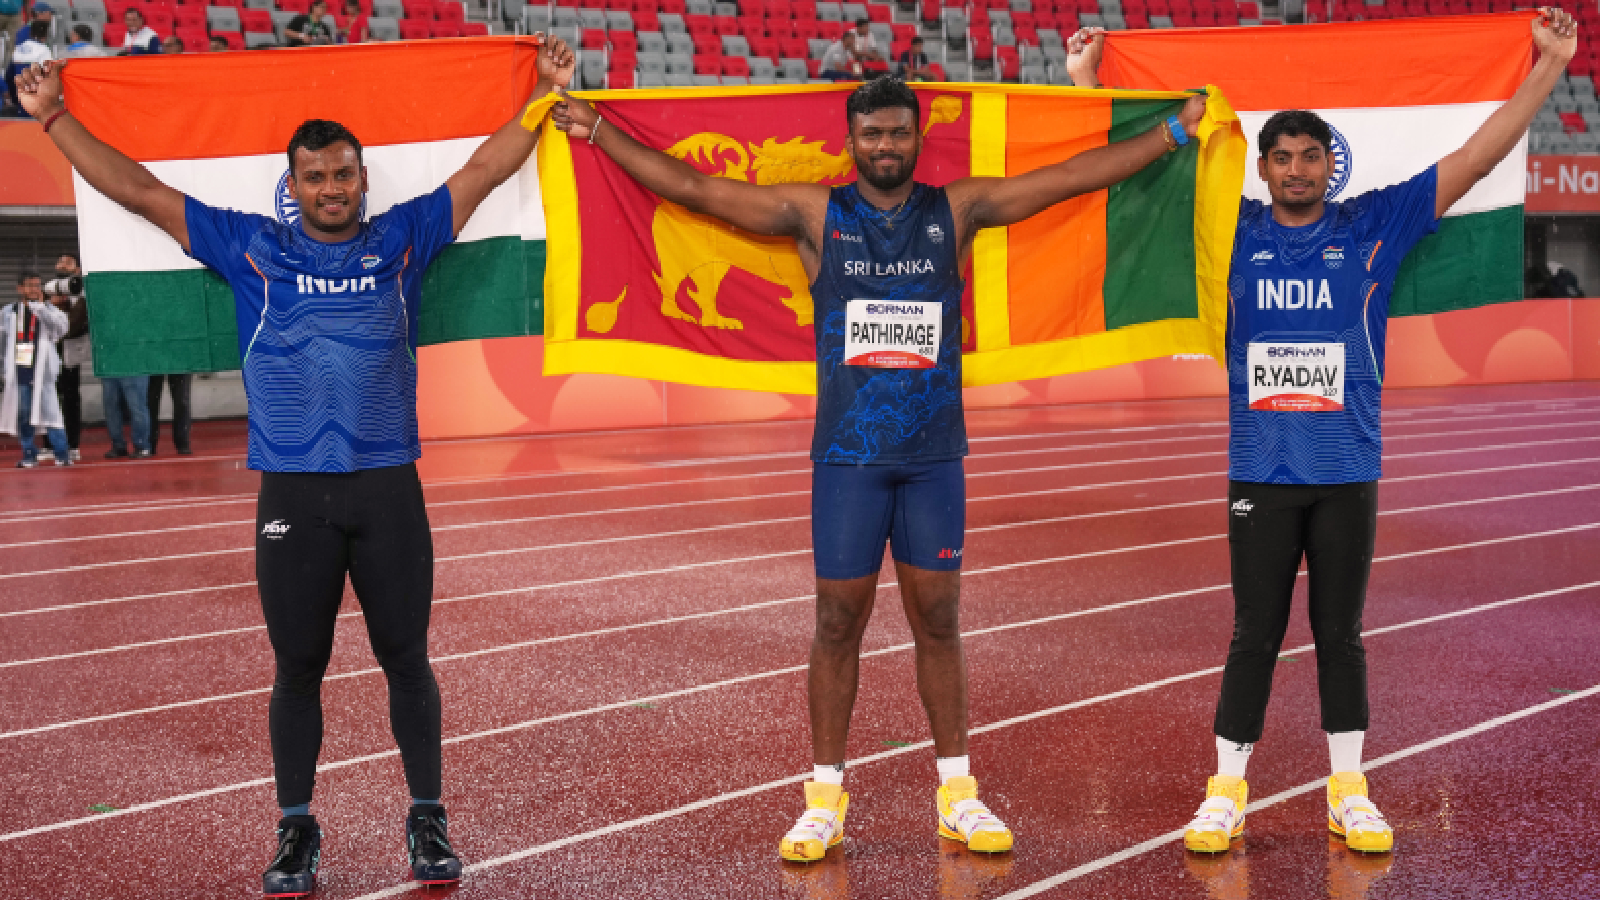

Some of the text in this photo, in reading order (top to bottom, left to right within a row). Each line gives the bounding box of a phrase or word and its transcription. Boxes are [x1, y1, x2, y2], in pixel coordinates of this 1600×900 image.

[844, 258, 936, 276] SRI LANKA
[1256, 278, 1334, 311] INDIA
[865, 303, 924, 315] BORNAN
[850, 321, 936, 346] PATHIRAGE
[1265, 346, 1326, 358] BORNAN
[1253, 364, 1338, 388] R.YADAV
